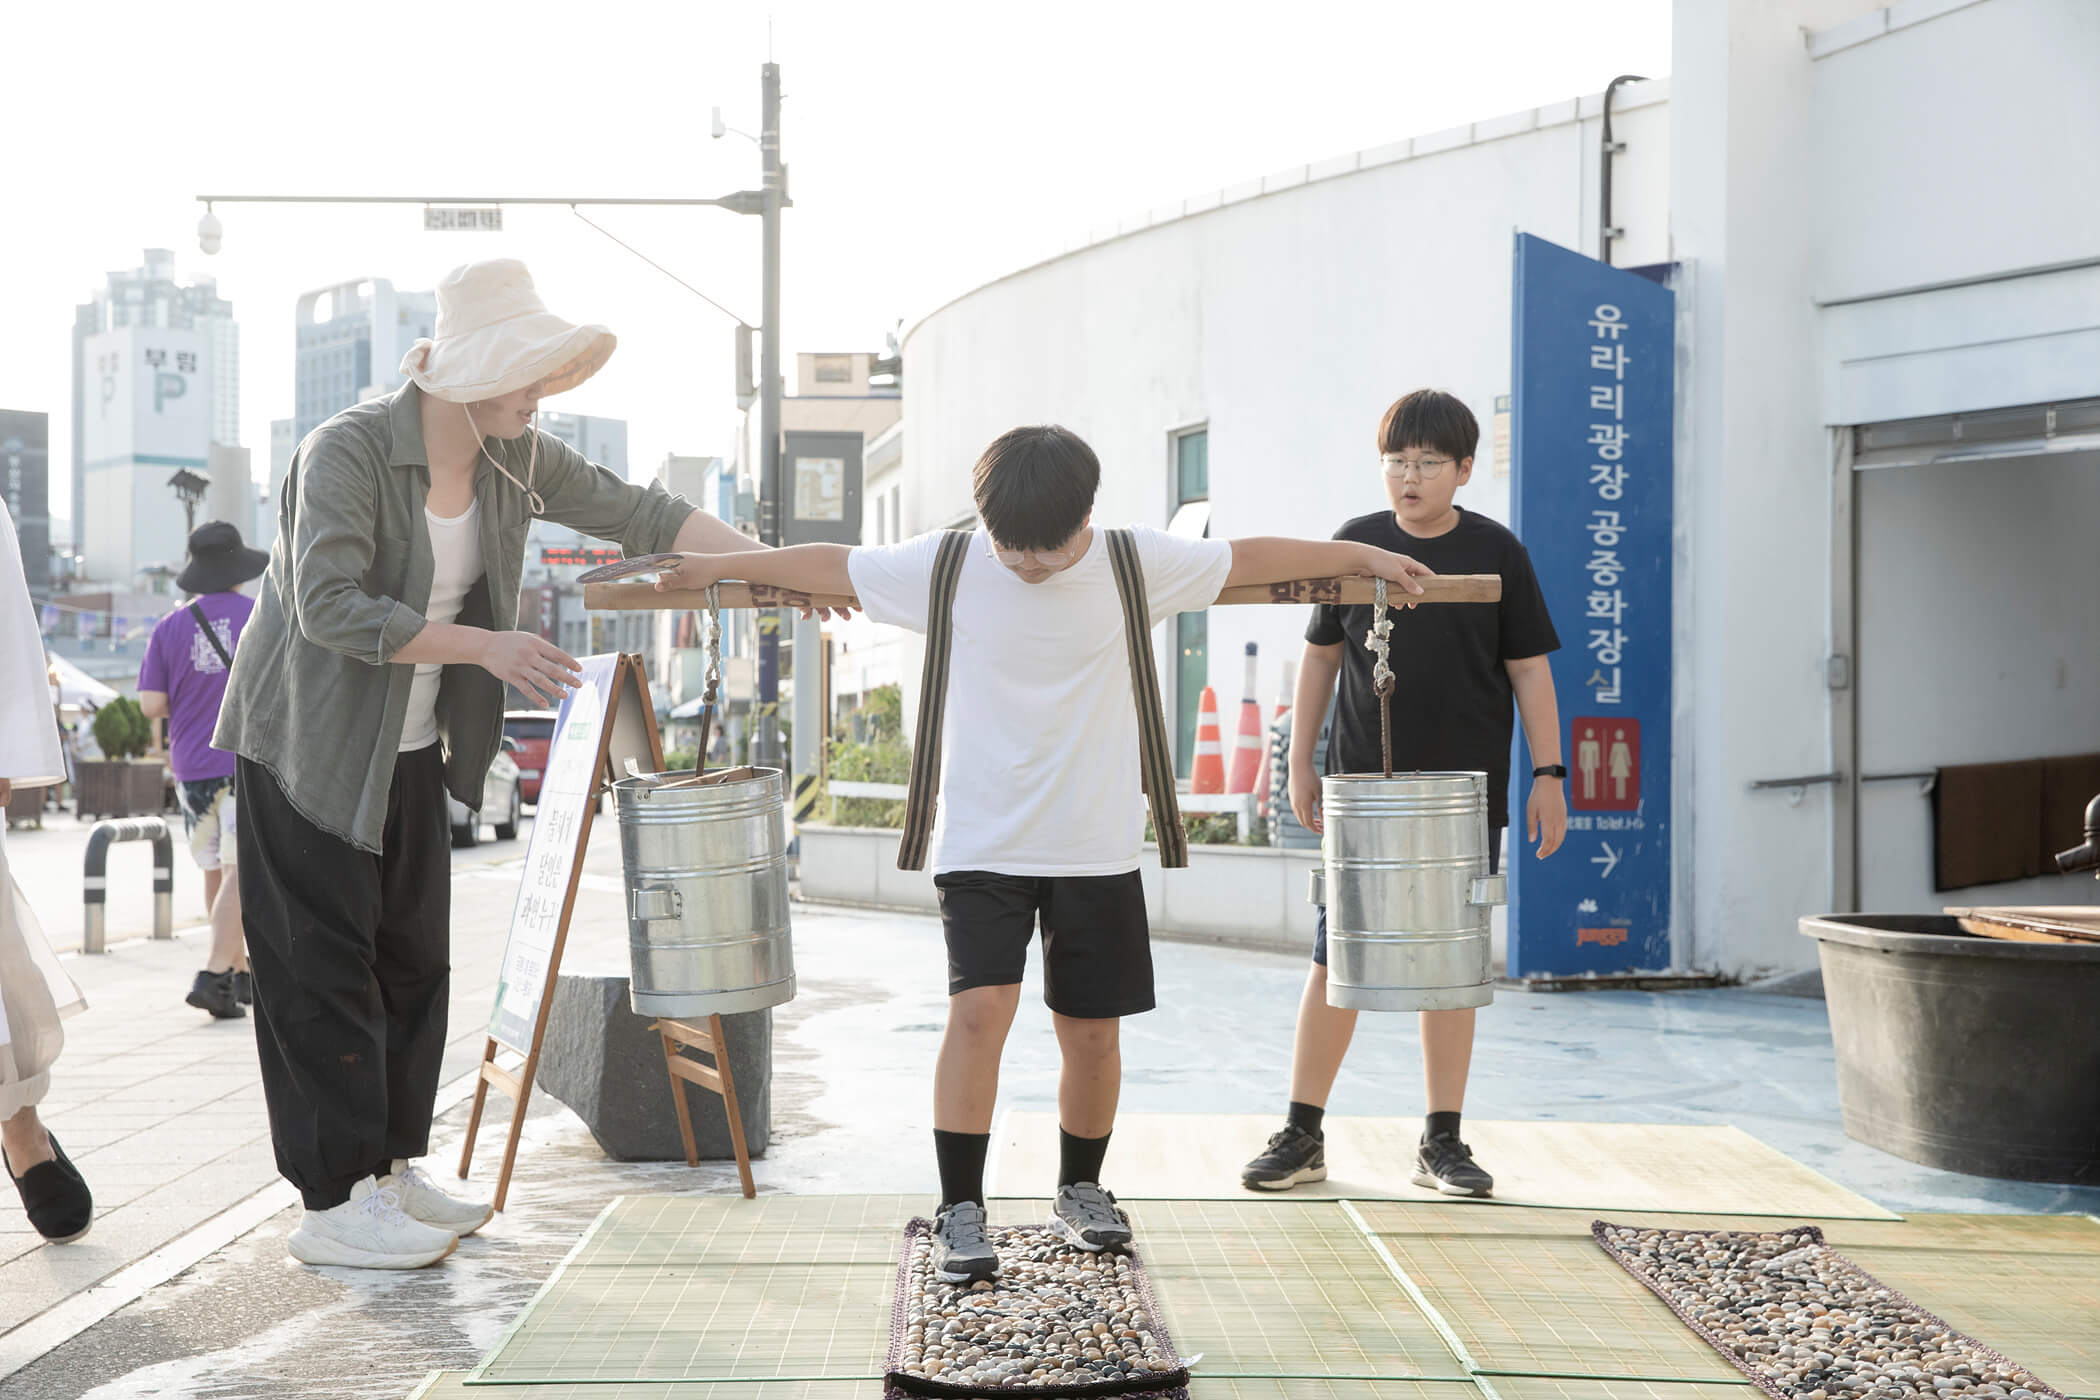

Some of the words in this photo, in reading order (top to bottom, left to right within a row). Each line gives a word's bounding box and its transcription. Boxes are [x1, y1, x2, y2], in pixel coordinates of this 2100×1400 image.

[154, 373, 187, 415] P
[1587, 303, 1631, 501] 유라리광장
[1585, 510, 1629, 704] 공중화장실
